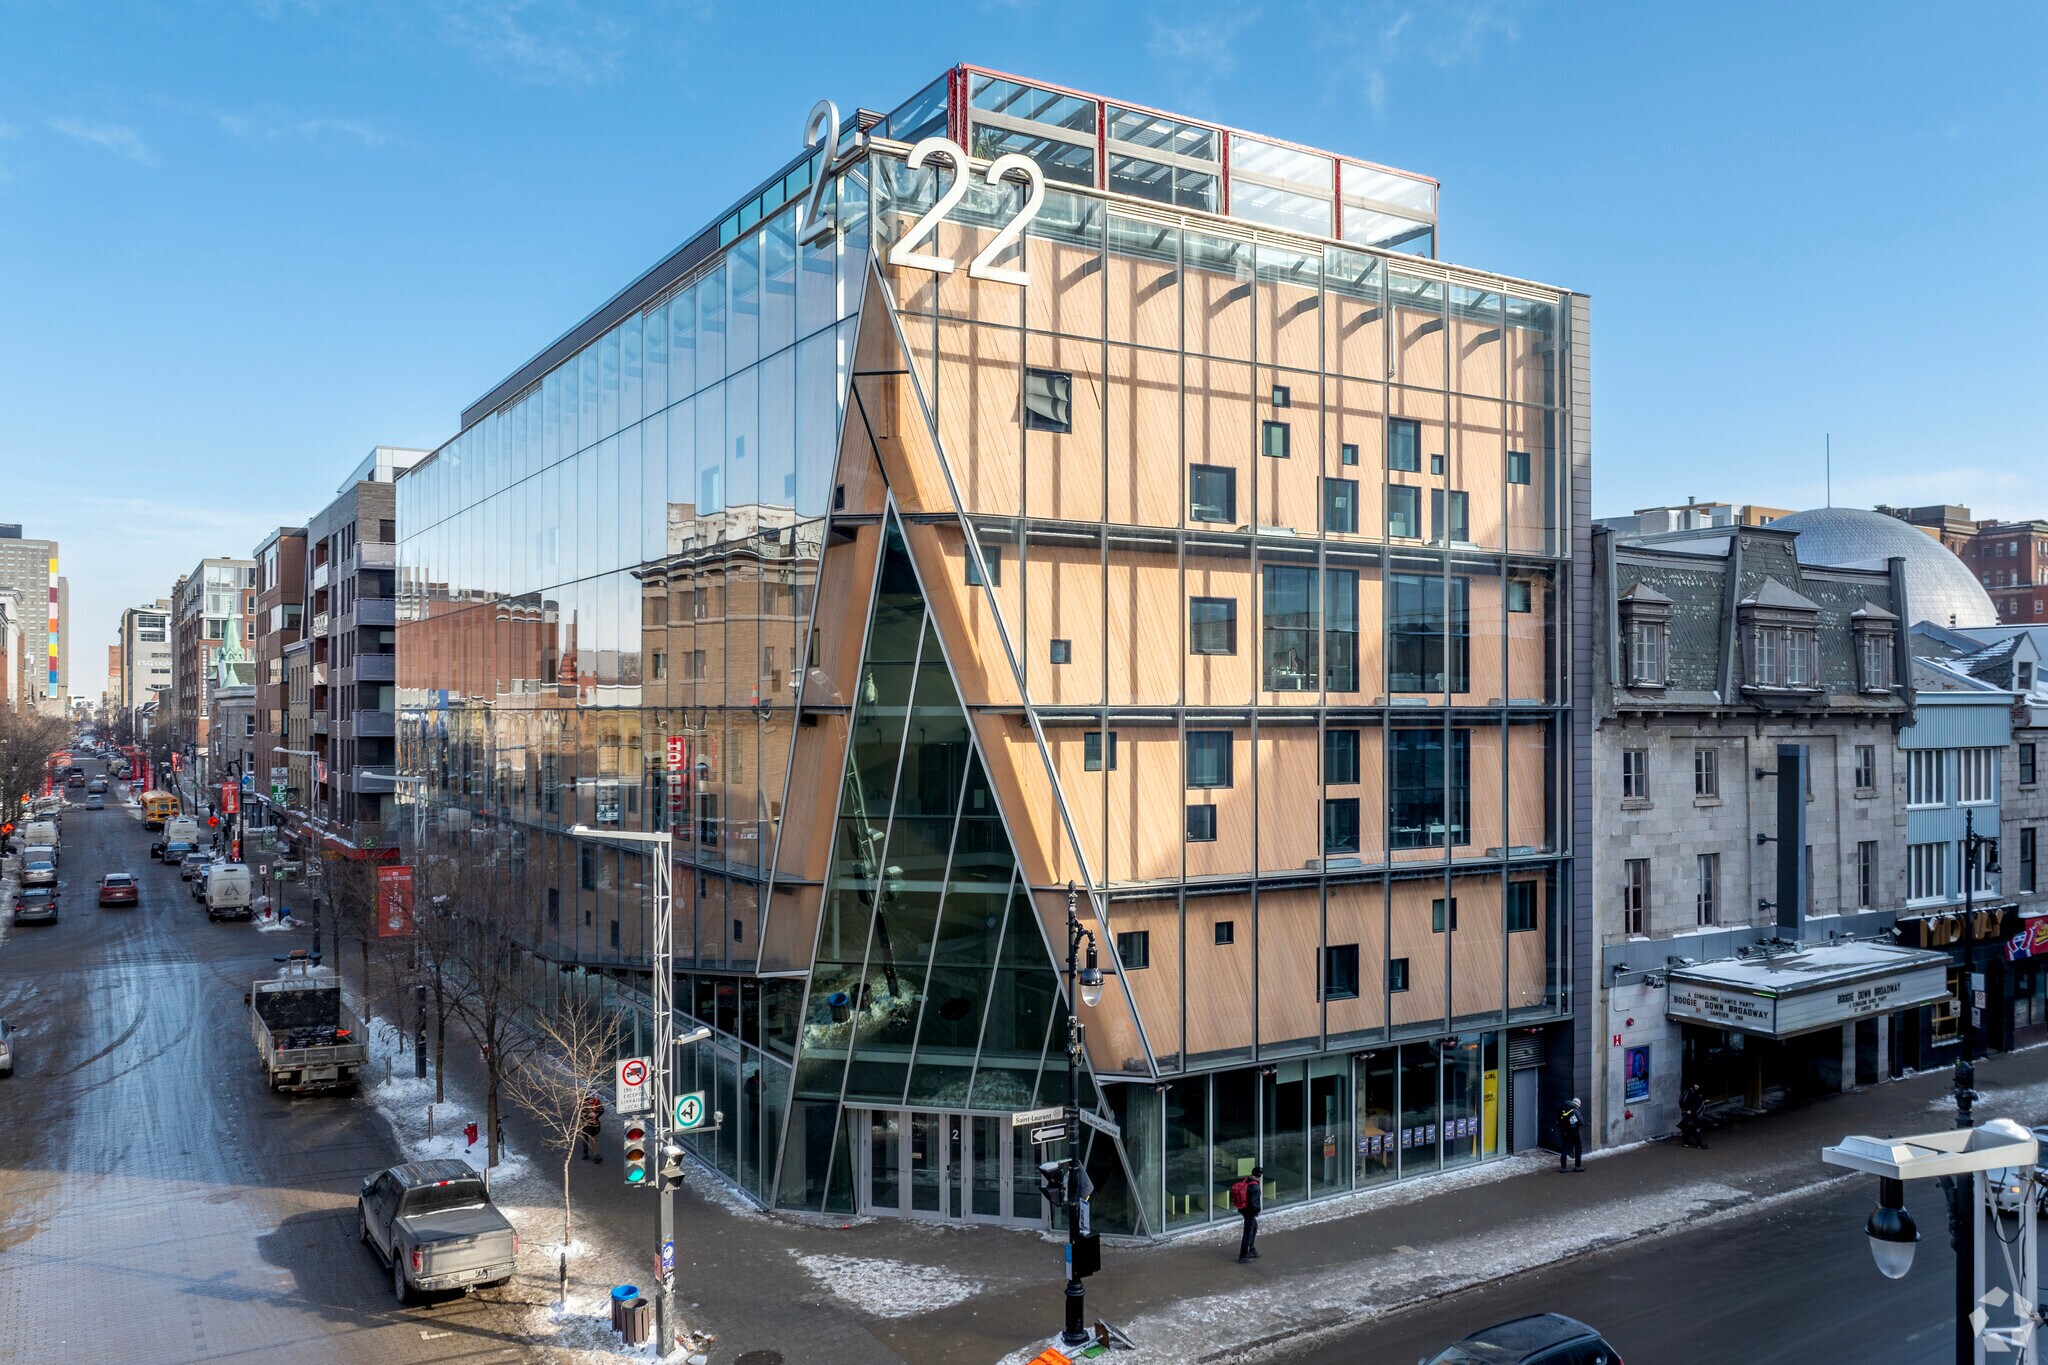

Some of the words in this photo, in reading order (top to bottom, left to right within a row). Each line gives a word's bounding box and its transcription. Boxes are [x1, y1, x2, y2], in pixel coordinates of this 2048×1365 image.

[1694, 993, 1719, 1002] SINGALONG
[1837, 992, 1855, 1004] BOOGIE
[1857, 989, 1872, 1000] DOWN
[1874, 982, 1901, 996] BROADWAY
[1673, 996, 1697, 1007] BOOGIE
[1704, 1001, 1724, 1011] DOWN
[1728, 1006, 1769, 1019] BROADWAY
[1015, 1113, 1052, 1124] Saint-Laurent
[952, 1129, 959, 1140] 2
